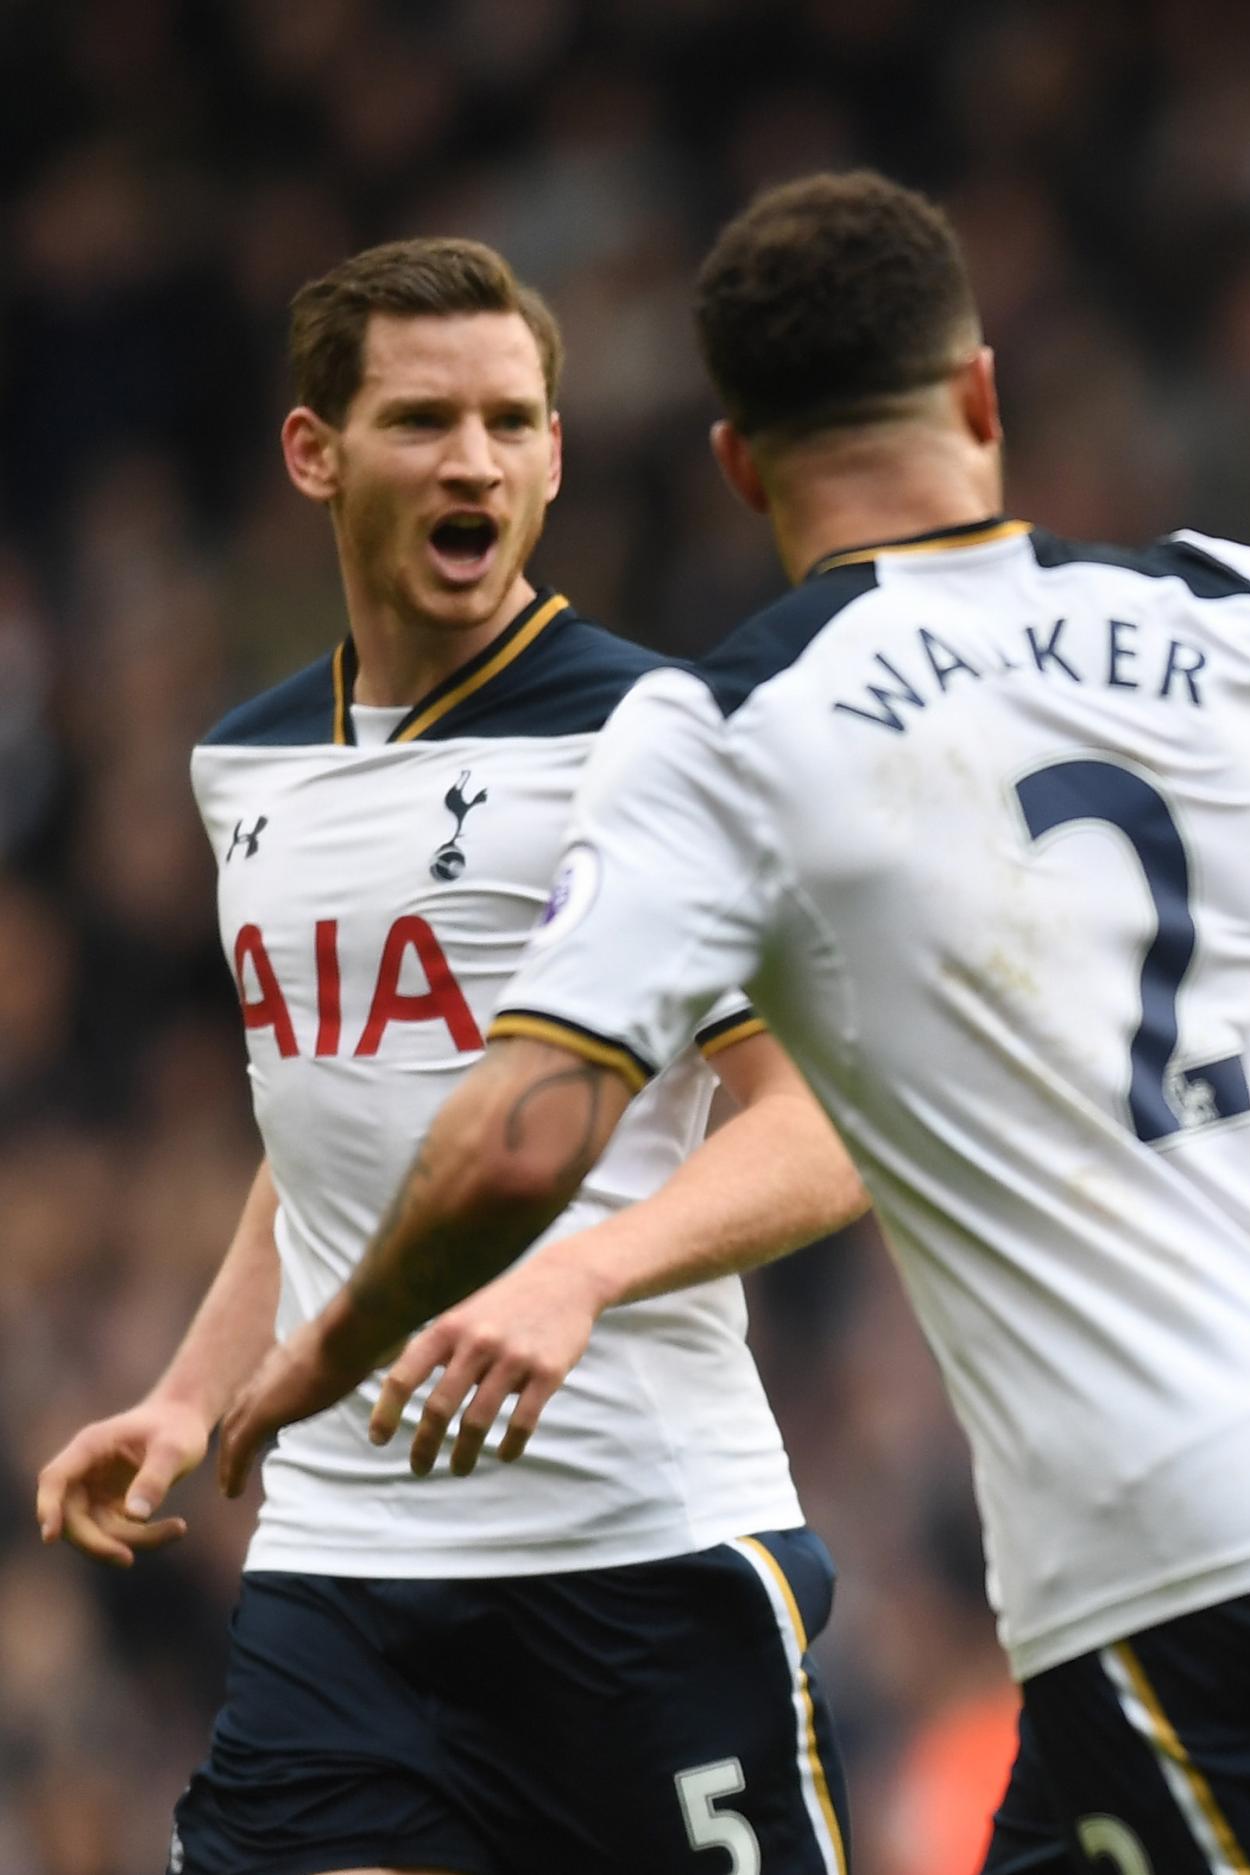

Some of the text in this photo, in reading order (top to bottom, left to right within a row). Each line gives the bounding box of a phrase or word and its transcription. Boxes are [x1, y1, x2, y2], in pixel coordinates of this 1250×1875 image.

[833, 618, 1206, 733] WAKER
[234, 915, 486, 1058] AIA
[673, 1756, 762, 1875] 5
